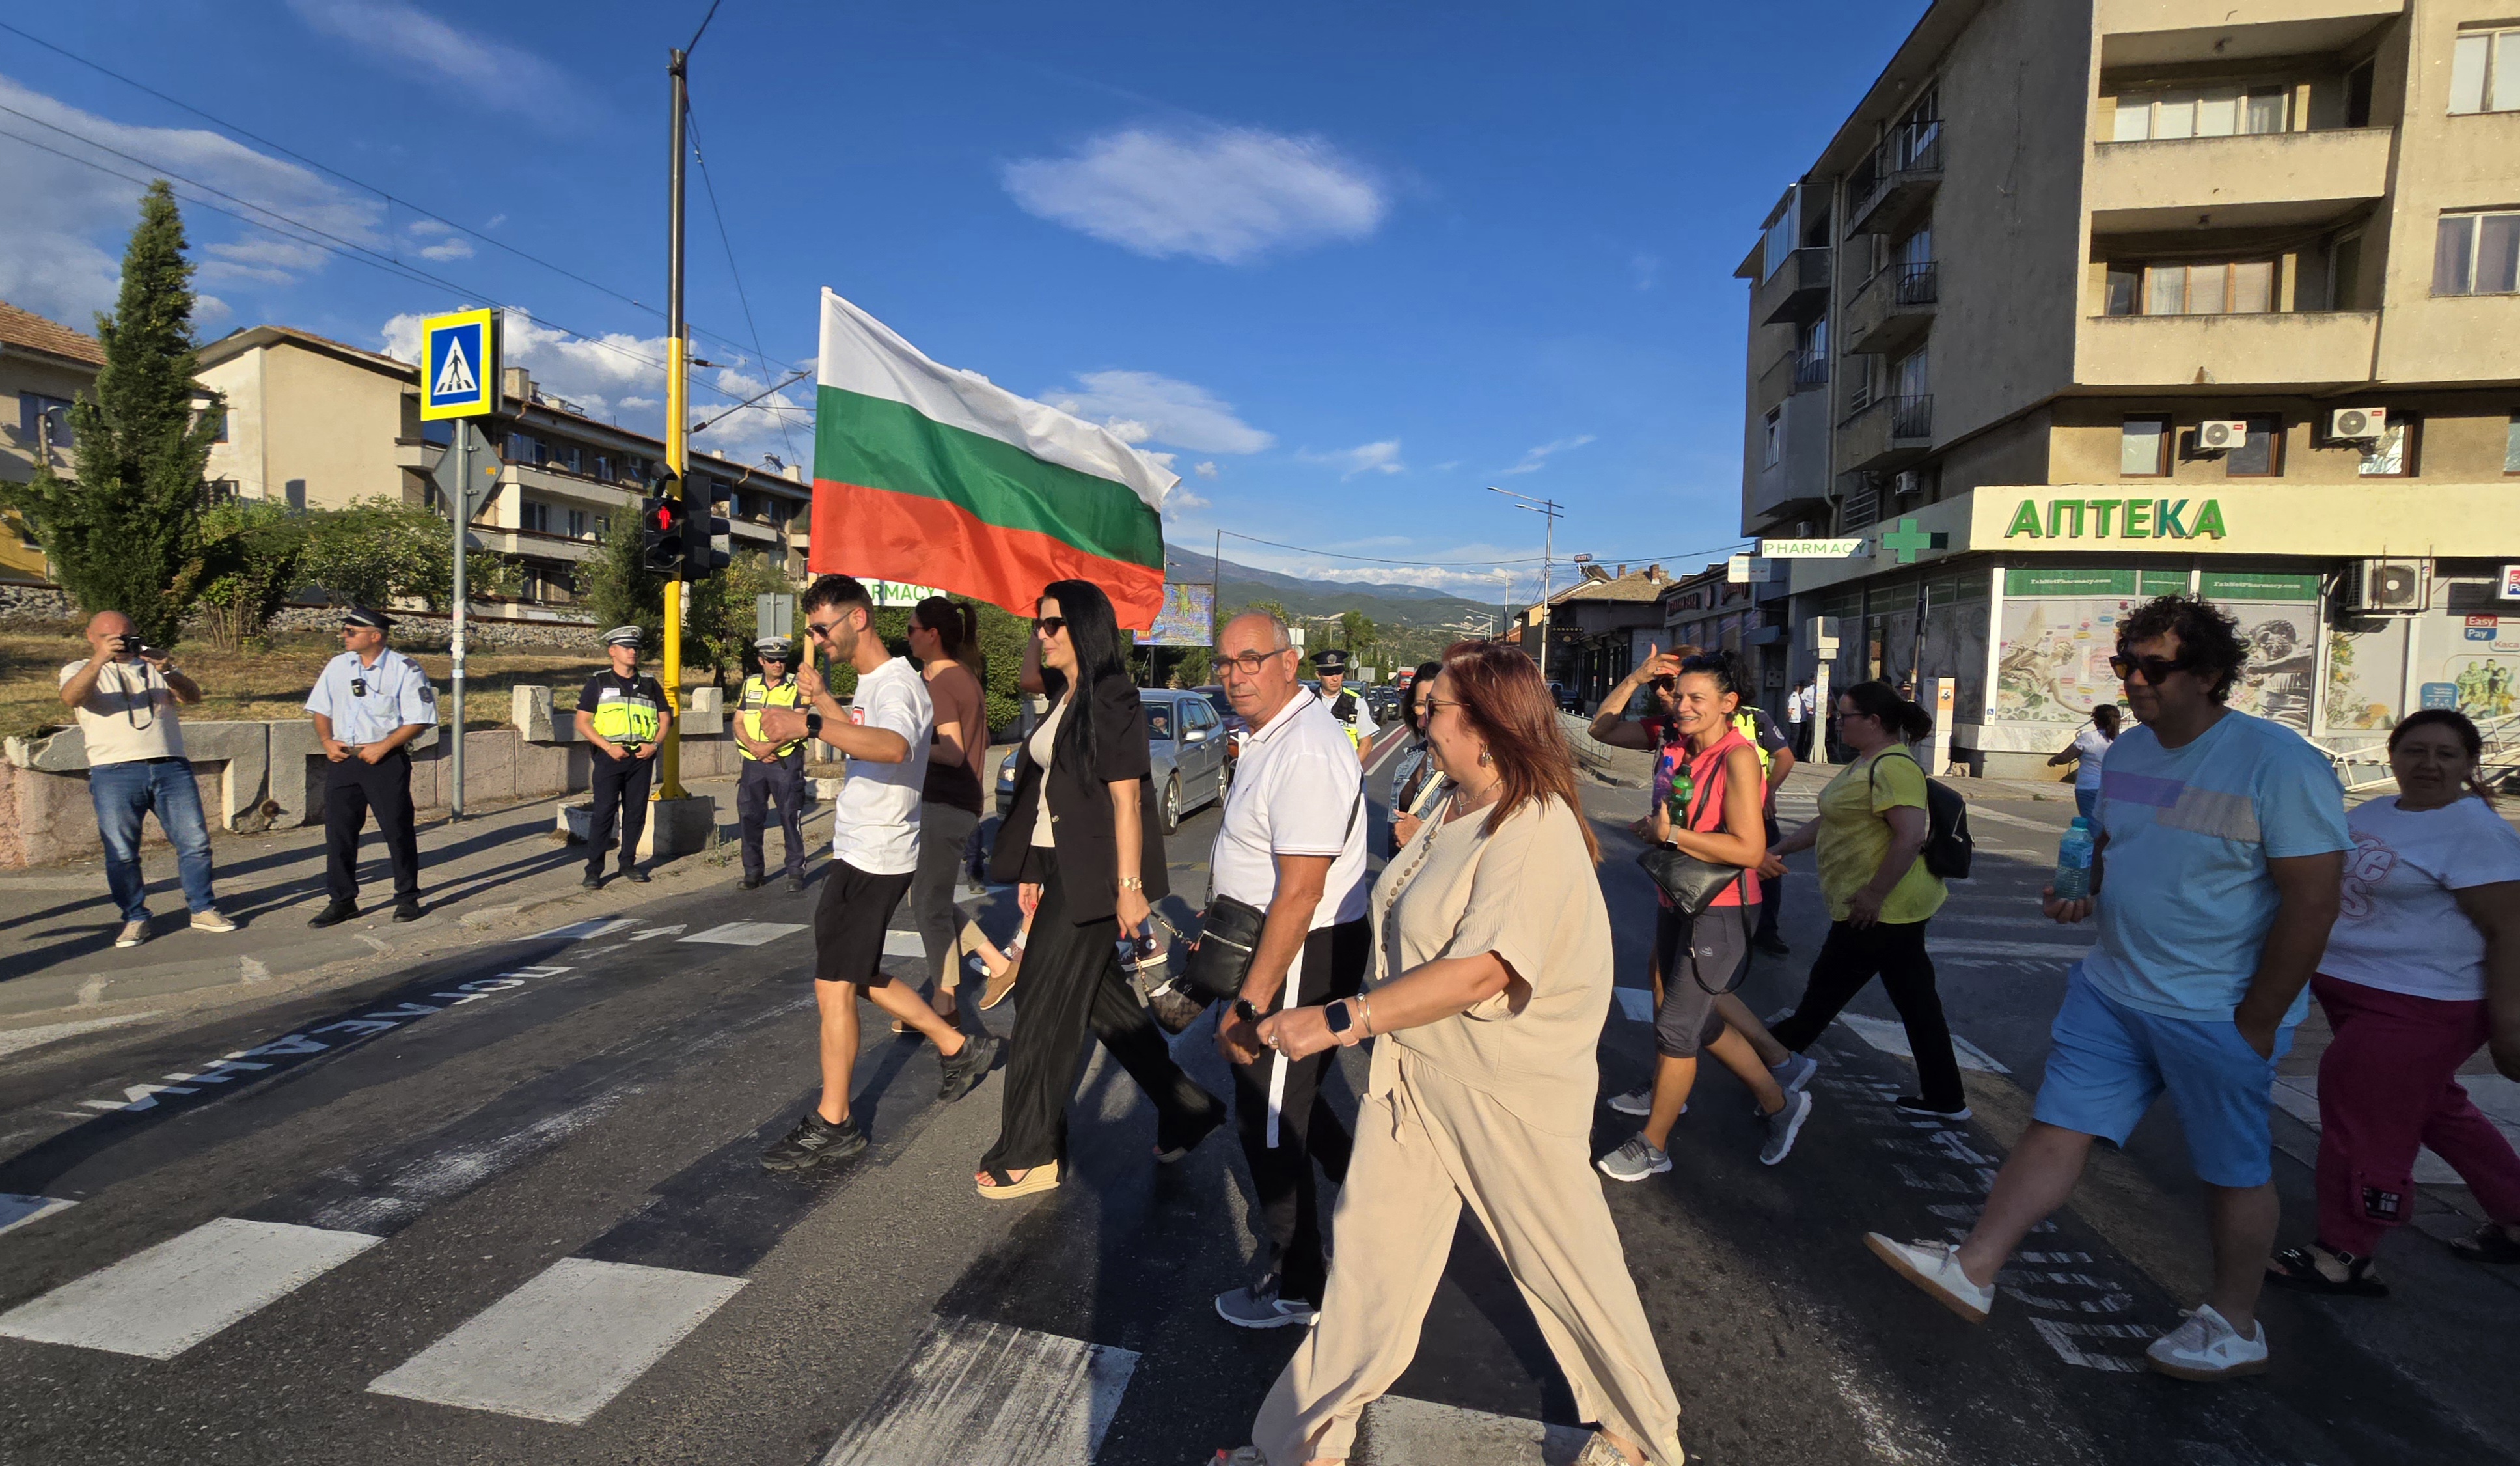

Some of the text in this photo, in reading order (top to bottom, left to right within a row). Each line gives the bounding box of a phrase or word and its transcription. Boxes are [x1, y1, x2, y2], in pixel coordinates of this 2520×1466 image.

[2004, 499, 2227, 539] АПТЕКА
[1764, 542, 1866, 554] PHARMACY
[864, 584, 935, 600] RMACY
[2469, 616, 2495, 626] Easy
[2467, 629, 2487, 639] Pay
